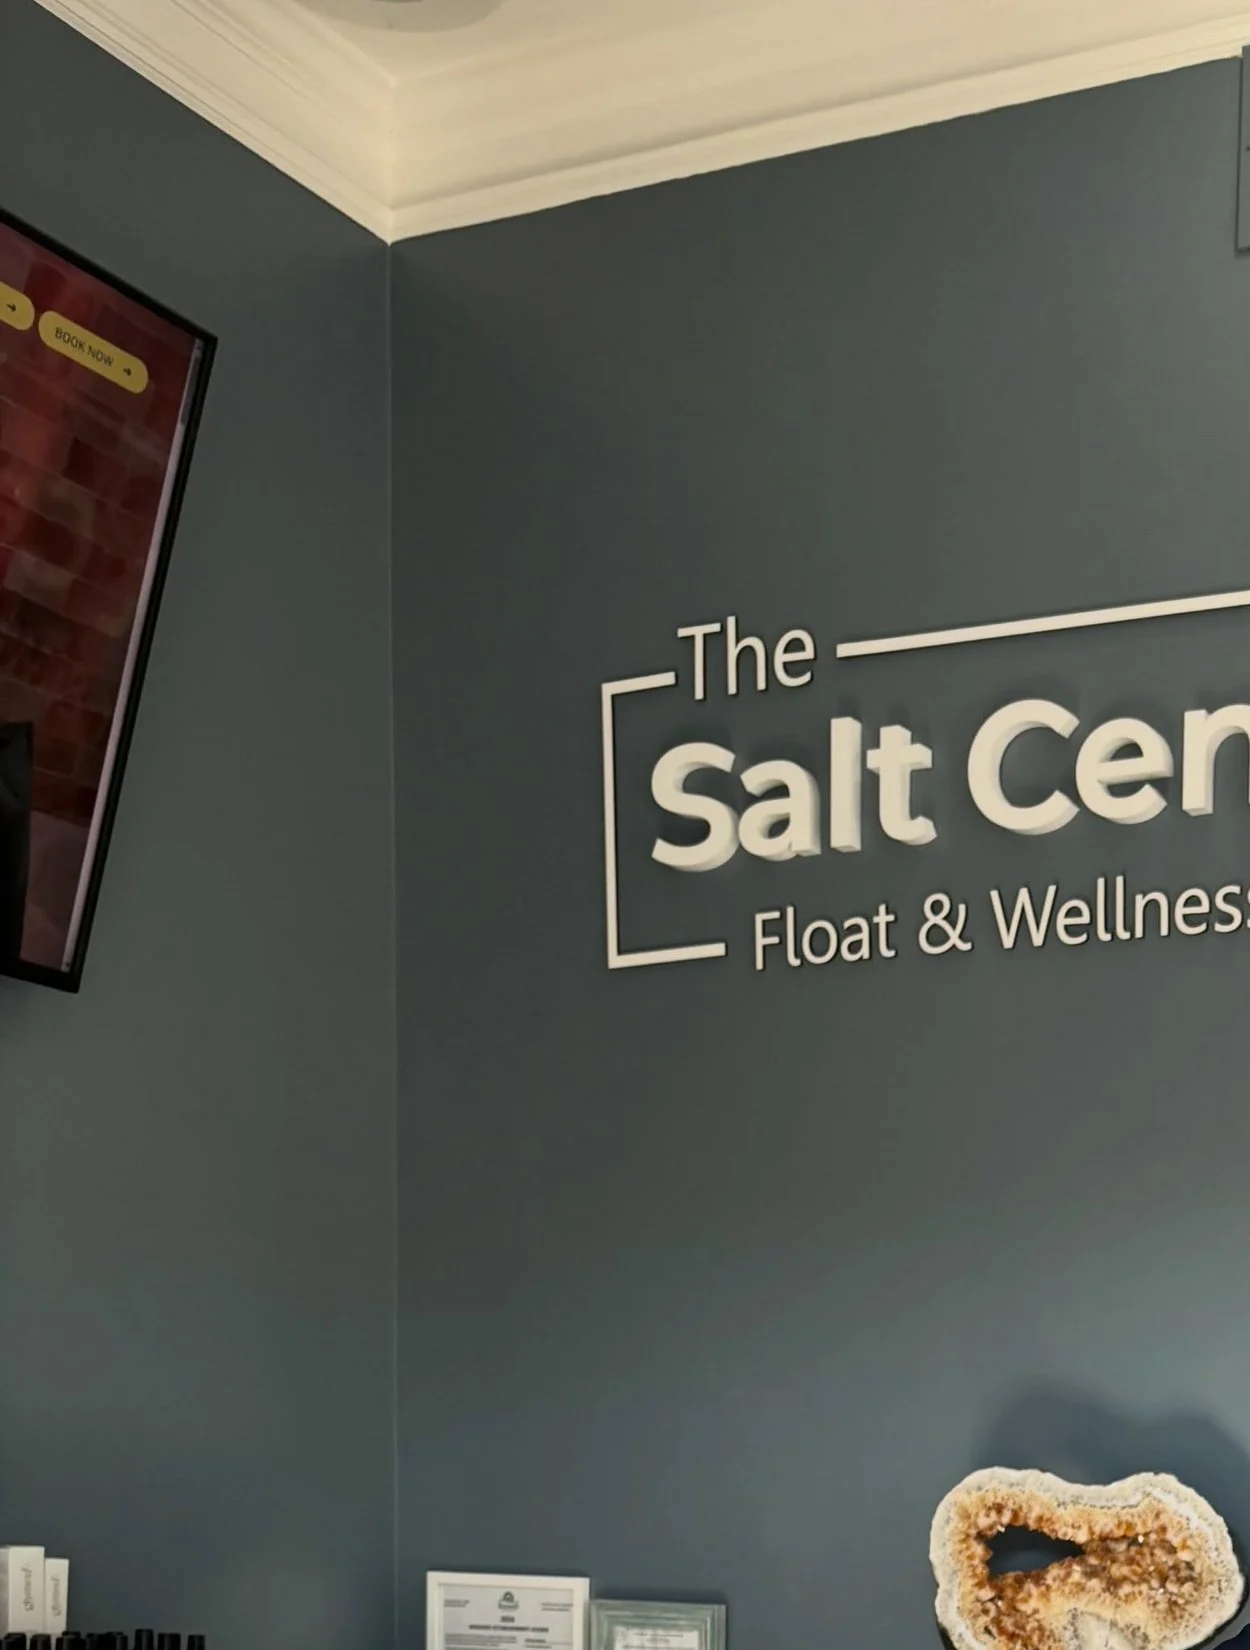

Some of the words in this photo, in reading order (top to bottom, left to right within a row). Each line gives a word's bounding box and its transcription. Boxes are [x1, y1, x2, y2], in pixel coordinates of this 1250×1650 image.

[54, 326, 86, 353] BOOK
[87, 345, 115, 368] NOW
[677, 614, 816, 702] The
[650, 716, 938, 873] Salt
[752, 905, 896, 973] Float
[917, 891, 973, 958] &
